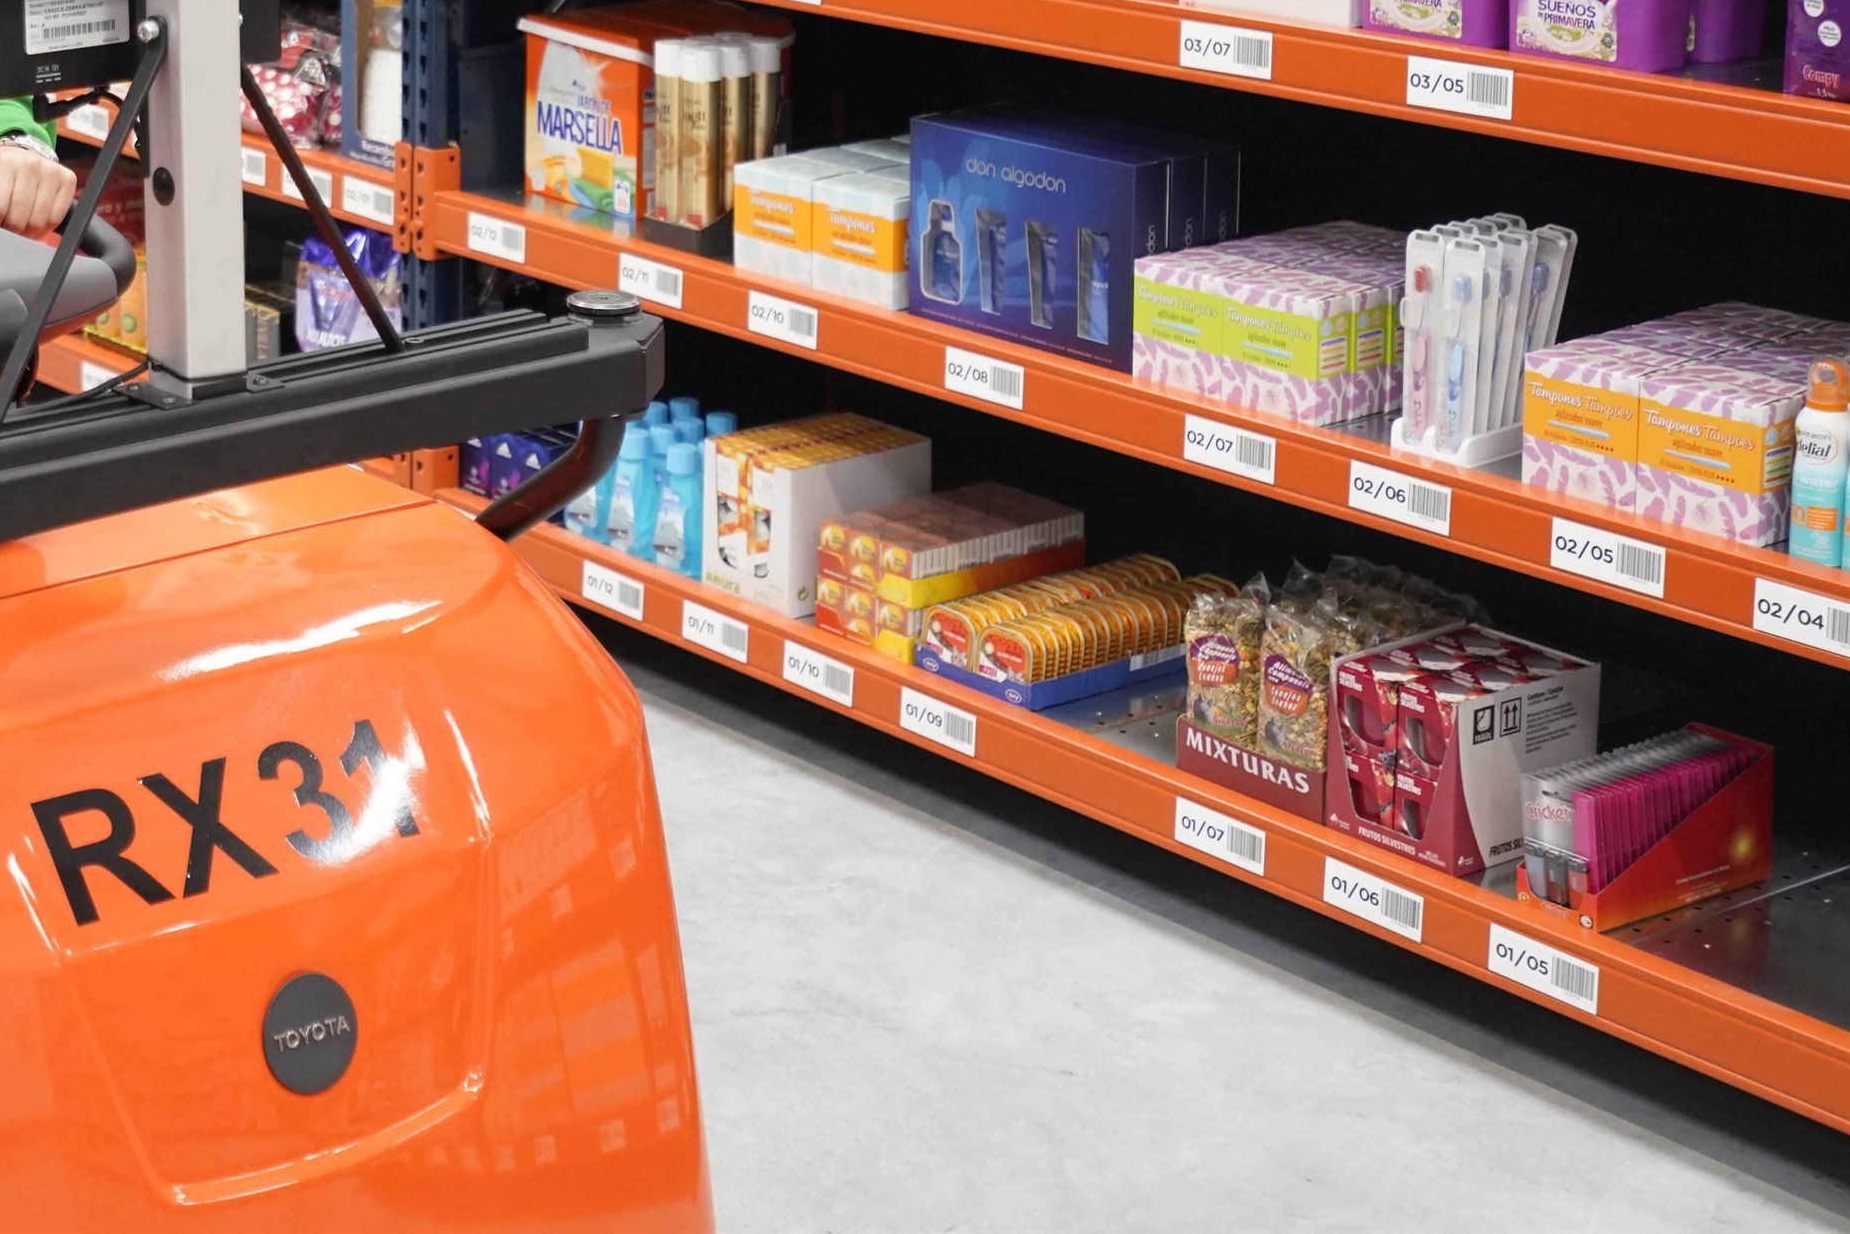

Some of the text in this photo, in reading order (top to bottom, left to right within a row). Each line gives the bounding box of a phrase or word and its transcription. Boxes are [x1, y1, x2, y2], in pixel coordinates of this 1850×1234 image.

[1544, 12, 1596, 30] PRIMAVERA
[1183, 37, 1231, 59] 03/07
[1409, 73, 1465, 96] 03/05
[536, 100, 622, 155] MARSELLA
[966, 157, 1067, 195] don algodon
[470, 223, 499, 242] 02/12
[827, 209, 878, 235] Tampones
[622, 265, 650, 283] 02/11
[1136, 285, 1178, 309] Tampones
[751, 305, 785, 325] 02/10
[1225, 307, 1271, 332] Tampones
[947, 359, 989, 385] 02/08
[1528, 381, 1583, 409] Tampones
[1643, 408, 1703, 437] Tampones
[1186, 428, 1234, 456] 02/07
[1353, 476, 1406, 505] 02/06
[1555, 535, 1614, 565] 02/05
[587, 572, 615, 596] 01/12
[686, 611, 715, 635] 01/11
[1757, 597, 1826, 632] 02/04
[787, 654, 820, 679] 01/10
[905, 700, 943, 729] 01/09
[1474, 732, 1494, 744] FRÁGIL
[1186, 727, 1310, 794] MIXTURAS
[1525, 801, 1572, 822] Cricket
[1181, 814, 1225, 843] 01/07
[1358, 825, 1416, 856] FRUTOS SILVESTRES
[1489, 839, 1510, 857] FRUTOS
[1331, 874, 1381, 906] 01/06
[1495, 942, 1550, 976] 01/05
[273, 1013, 351, 1054] TOYOTA
